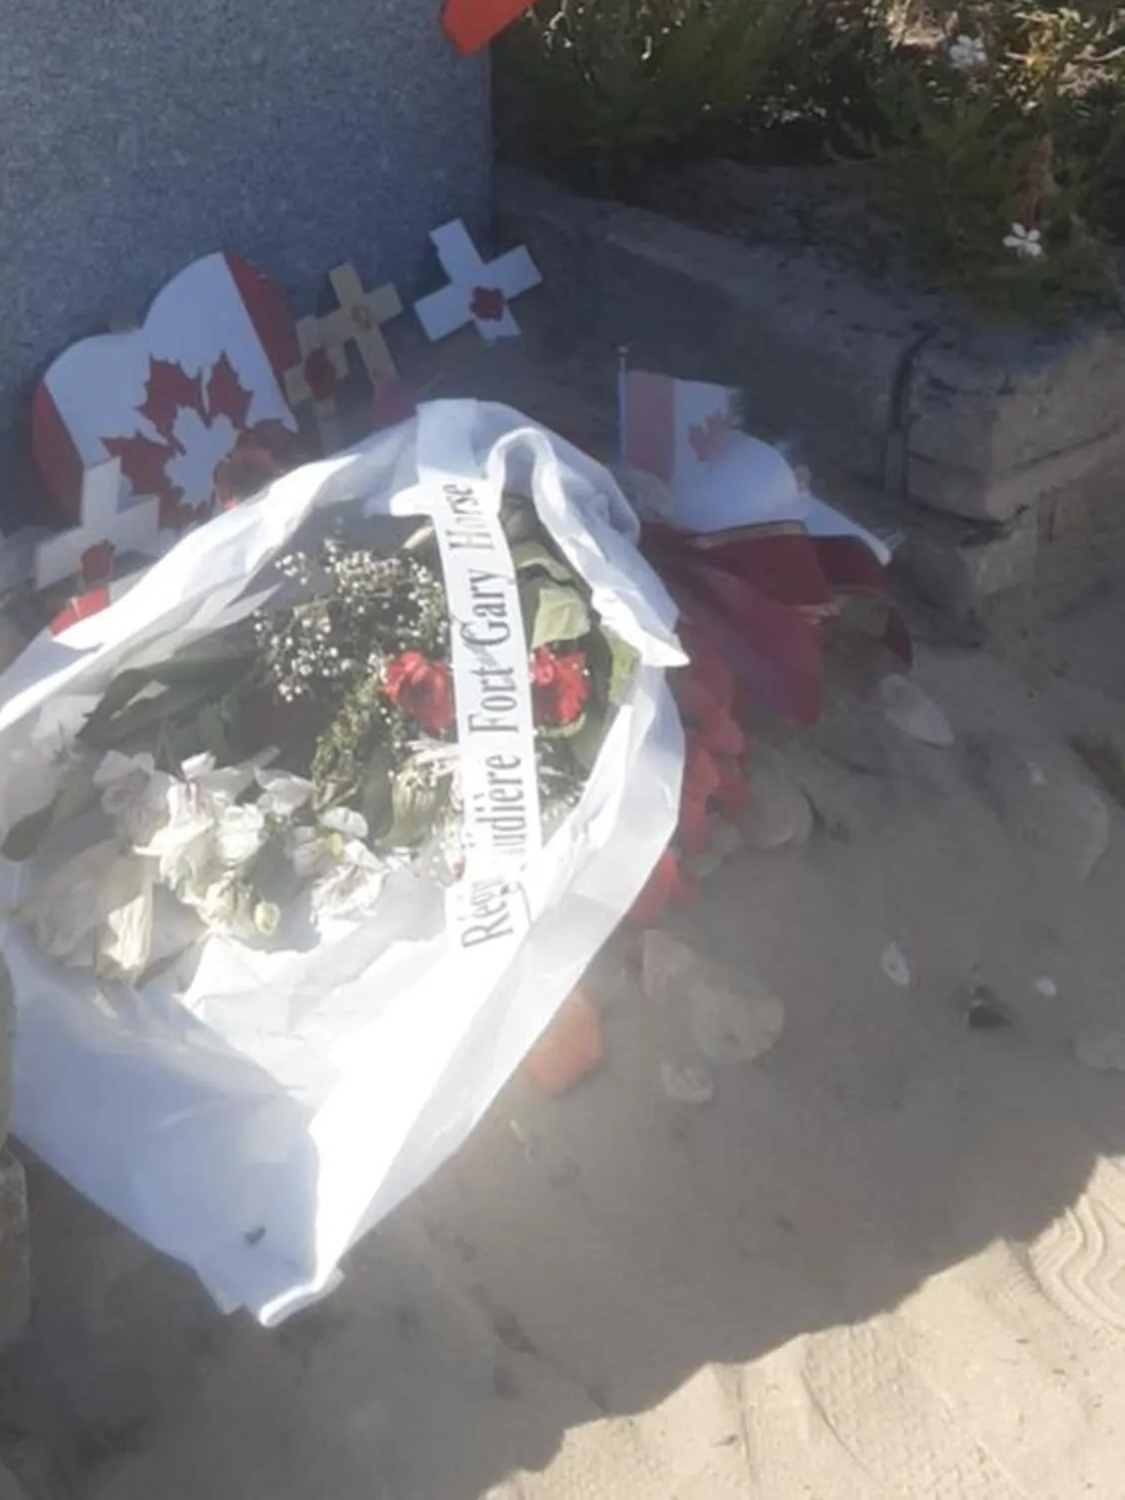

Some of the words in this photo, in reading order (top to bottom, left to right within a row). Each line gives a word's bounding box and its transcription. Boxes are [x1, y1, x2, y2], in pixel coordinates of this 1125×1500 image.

[442, 482, 496, 551] Horse
[459, 567, 516, 647] Gary
[467, 664, 519, 734] Fort
